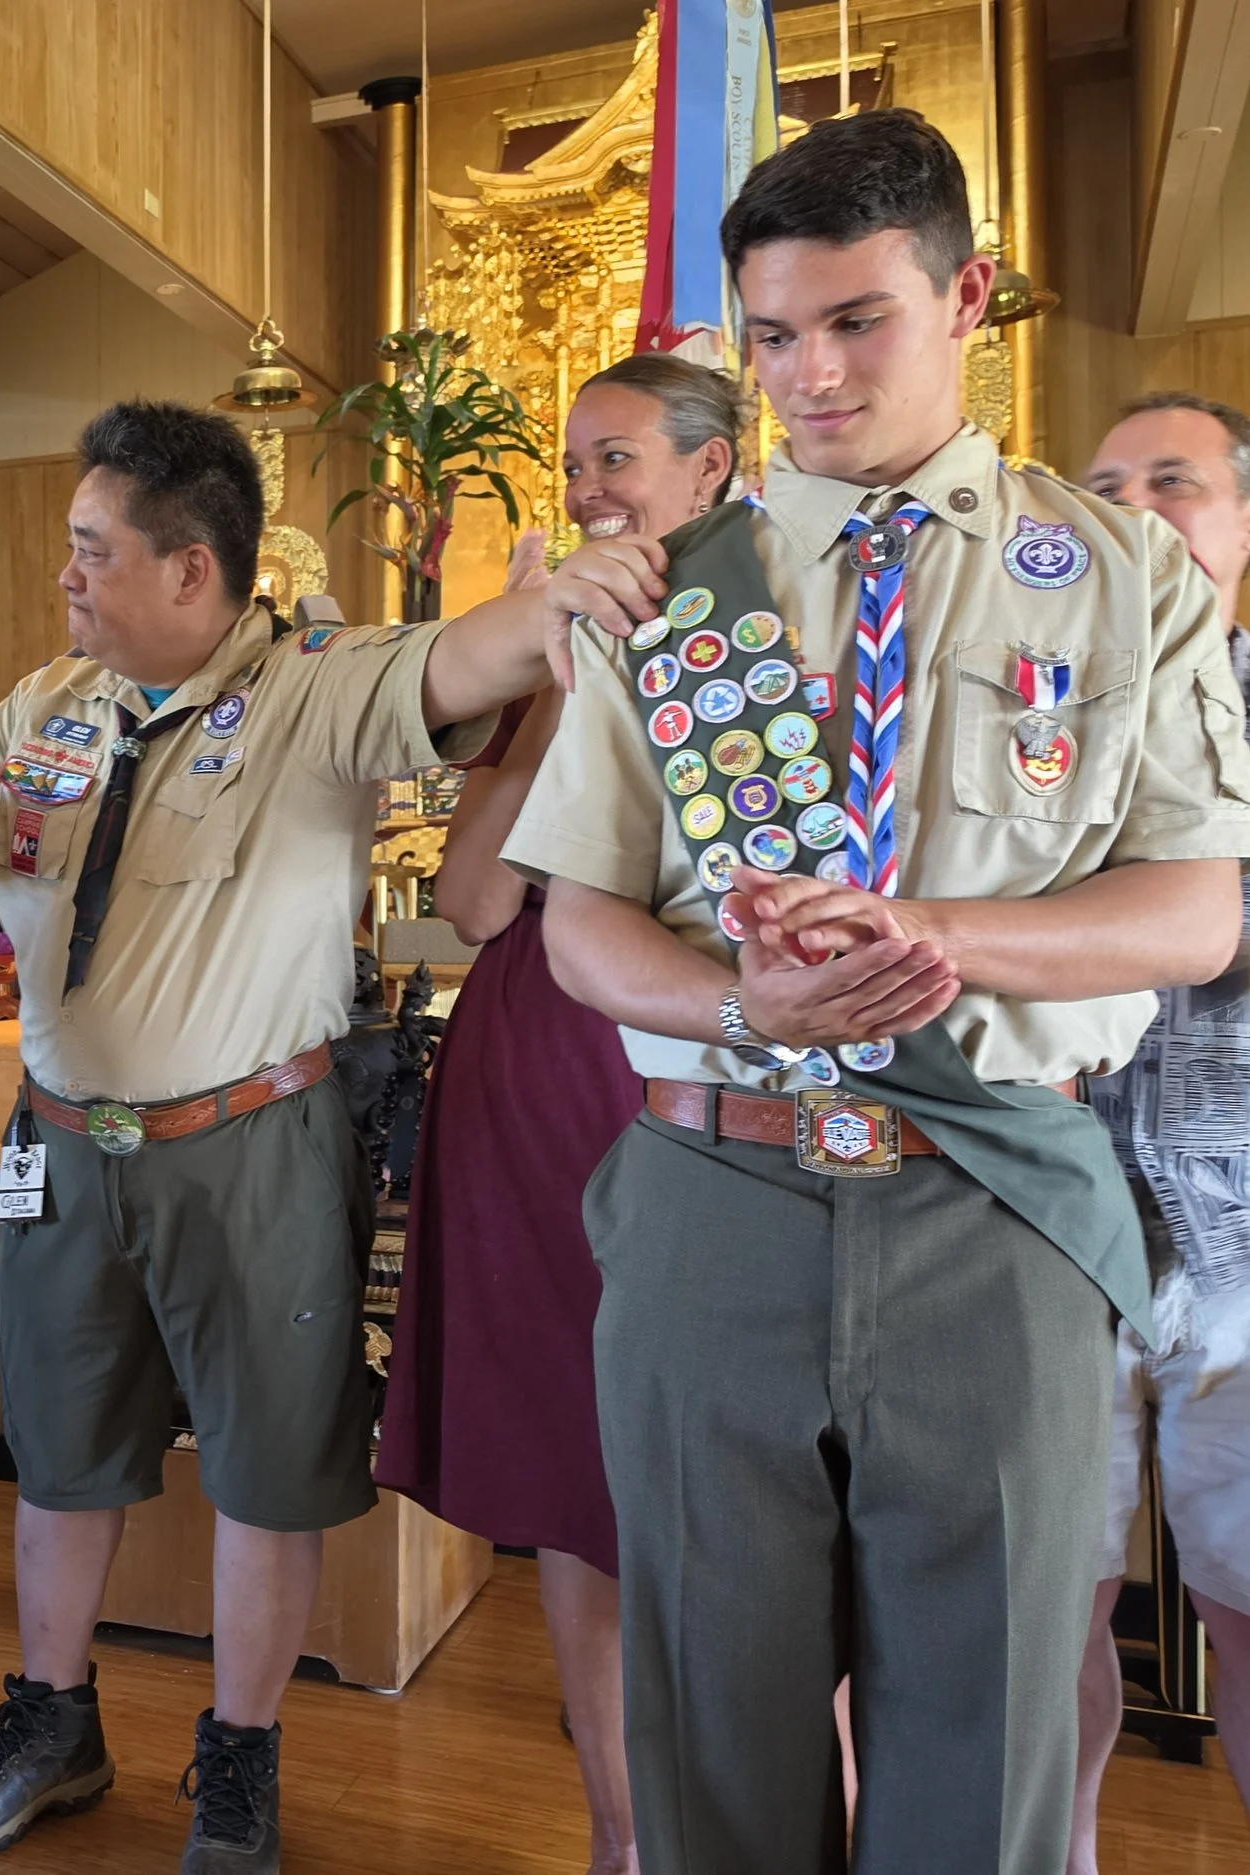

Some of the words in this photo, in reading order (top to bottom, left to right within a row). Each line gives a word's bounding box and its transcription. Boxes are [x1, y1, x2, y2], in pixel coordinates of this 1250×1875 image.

[731, 75, 743, 108] BOY
[730, 111, 743, 172] SCOUTS
[693, 804, 714, 826] SALE
